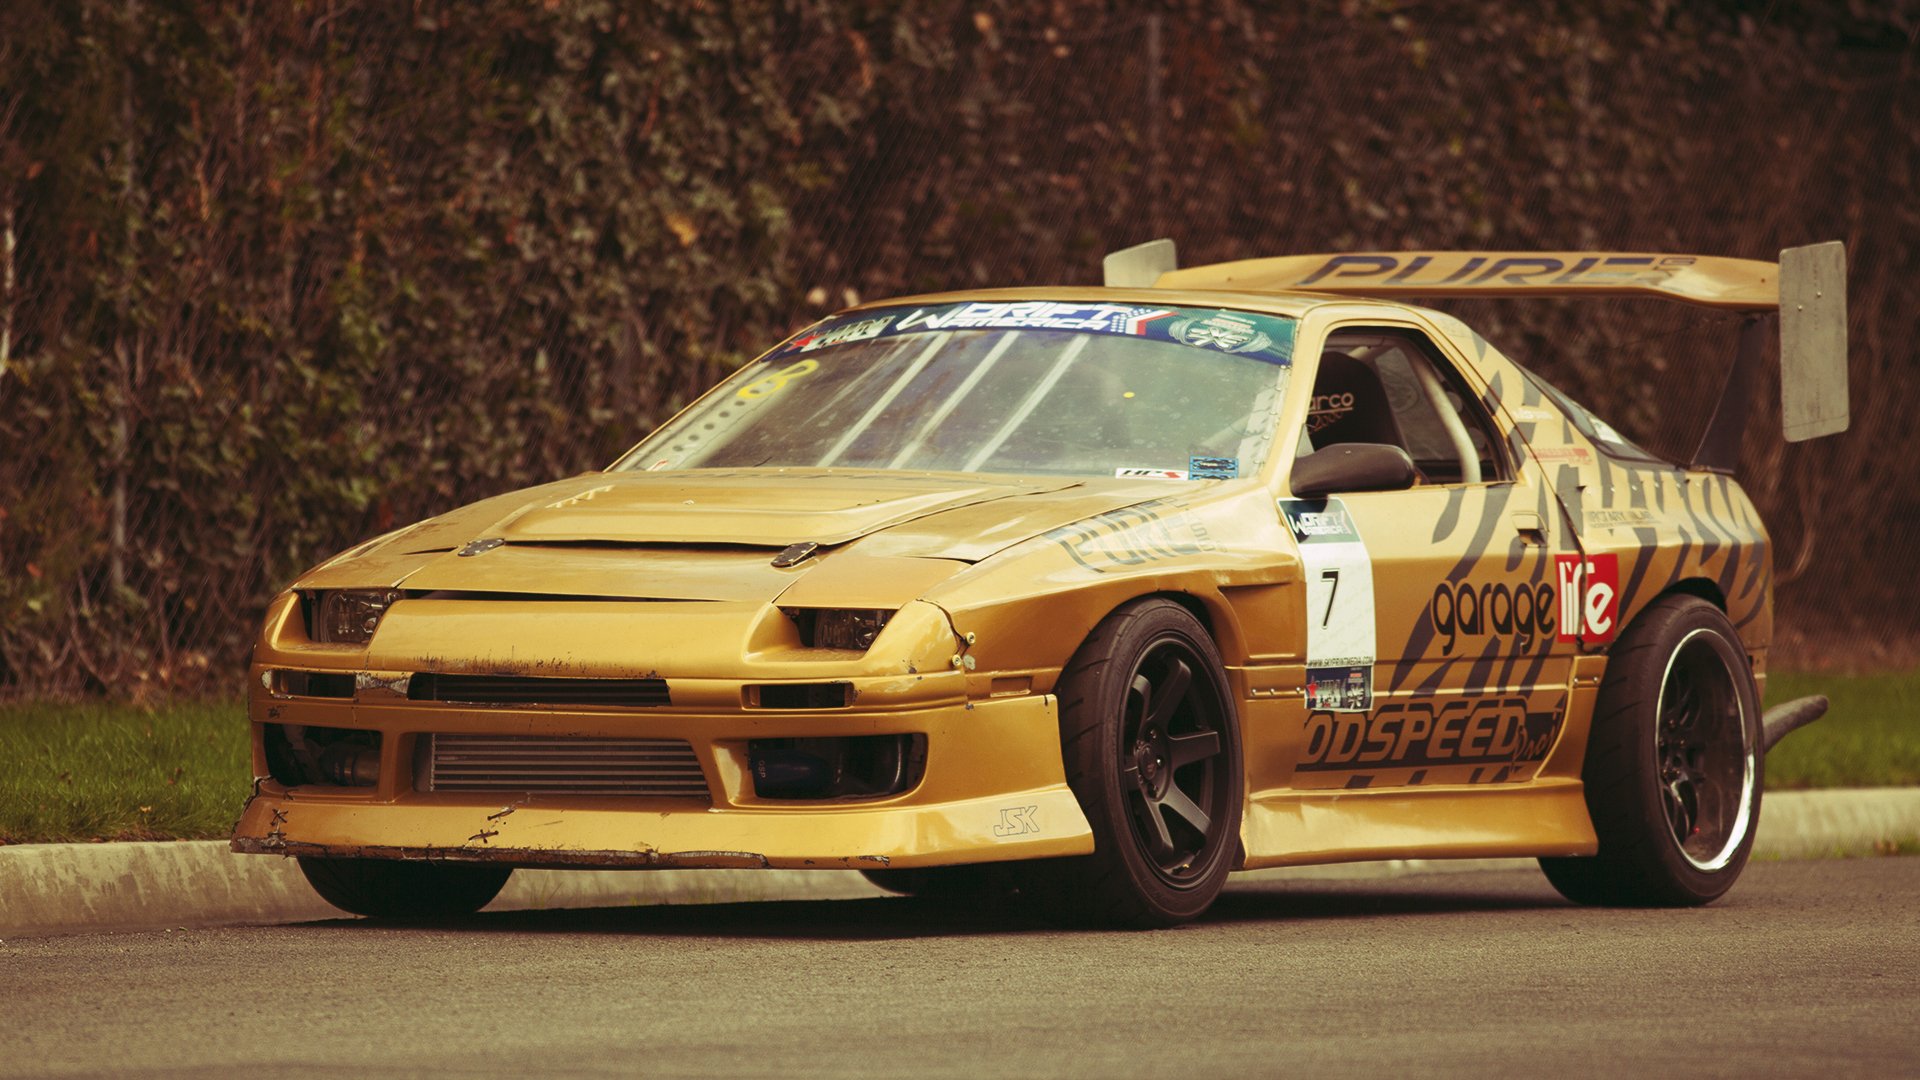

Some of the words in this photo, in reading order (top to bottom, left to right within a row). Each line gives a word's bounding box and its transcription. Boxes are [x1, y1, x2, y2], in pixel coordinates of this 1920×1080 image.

[940, 316, 1110, 331] AMERICA
[961, 301, 1131, 321] DRIFT
[1322, 570, 1339, 627] 7
[1433, 583, 1555, 656] garage
[993, 805, 1040, 837] JSK
